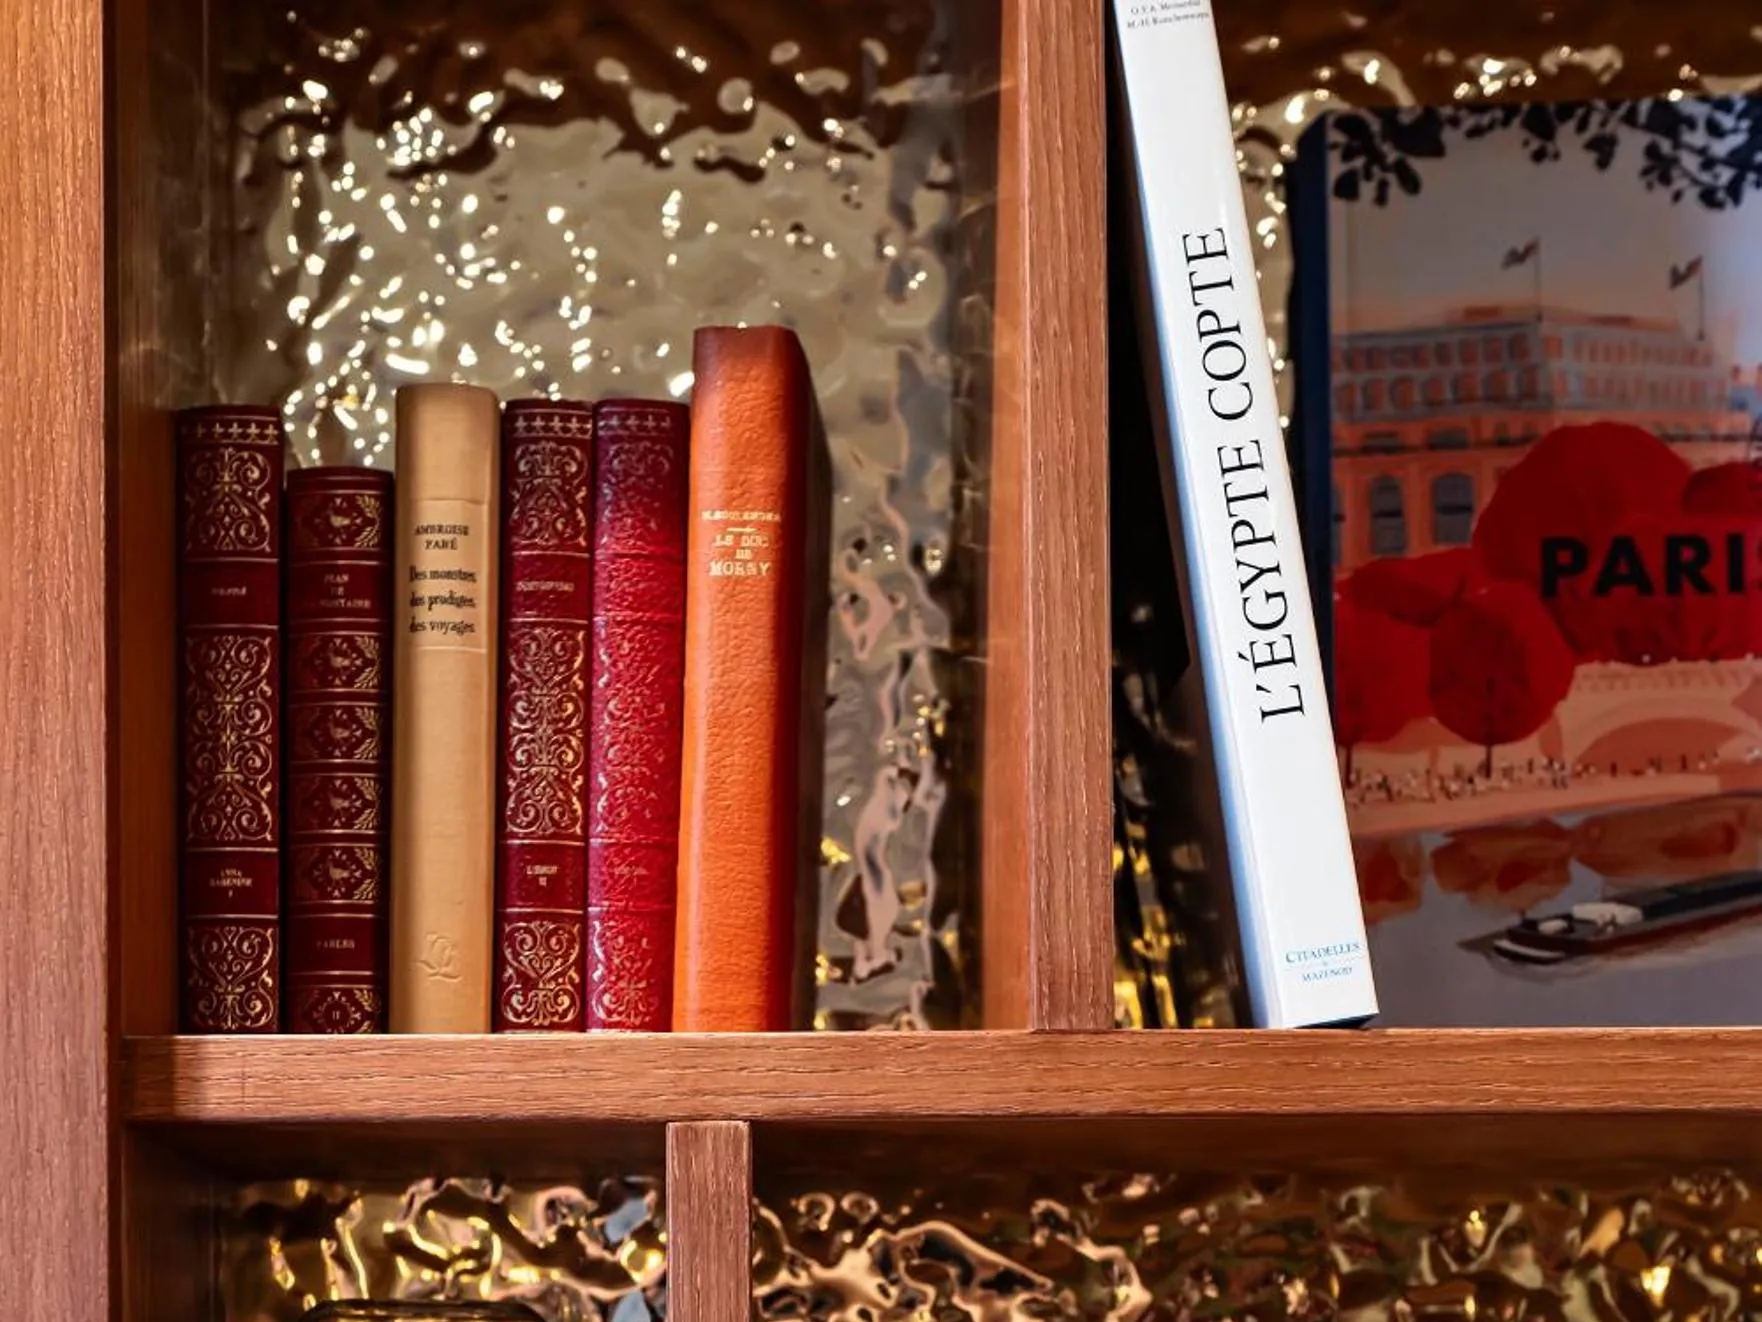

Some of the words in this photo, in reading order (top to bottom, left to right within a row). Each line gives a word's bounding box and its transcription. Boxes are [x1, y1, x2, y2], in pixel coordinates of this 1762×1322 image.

[1182, 227, 1254, 421] COPTE
[1217, 439, 1305, 724] L'ÉGYPTE
[1540, 532, 1762, 601] PARI
[1285, 942, 1361, 964] CITADELLES
